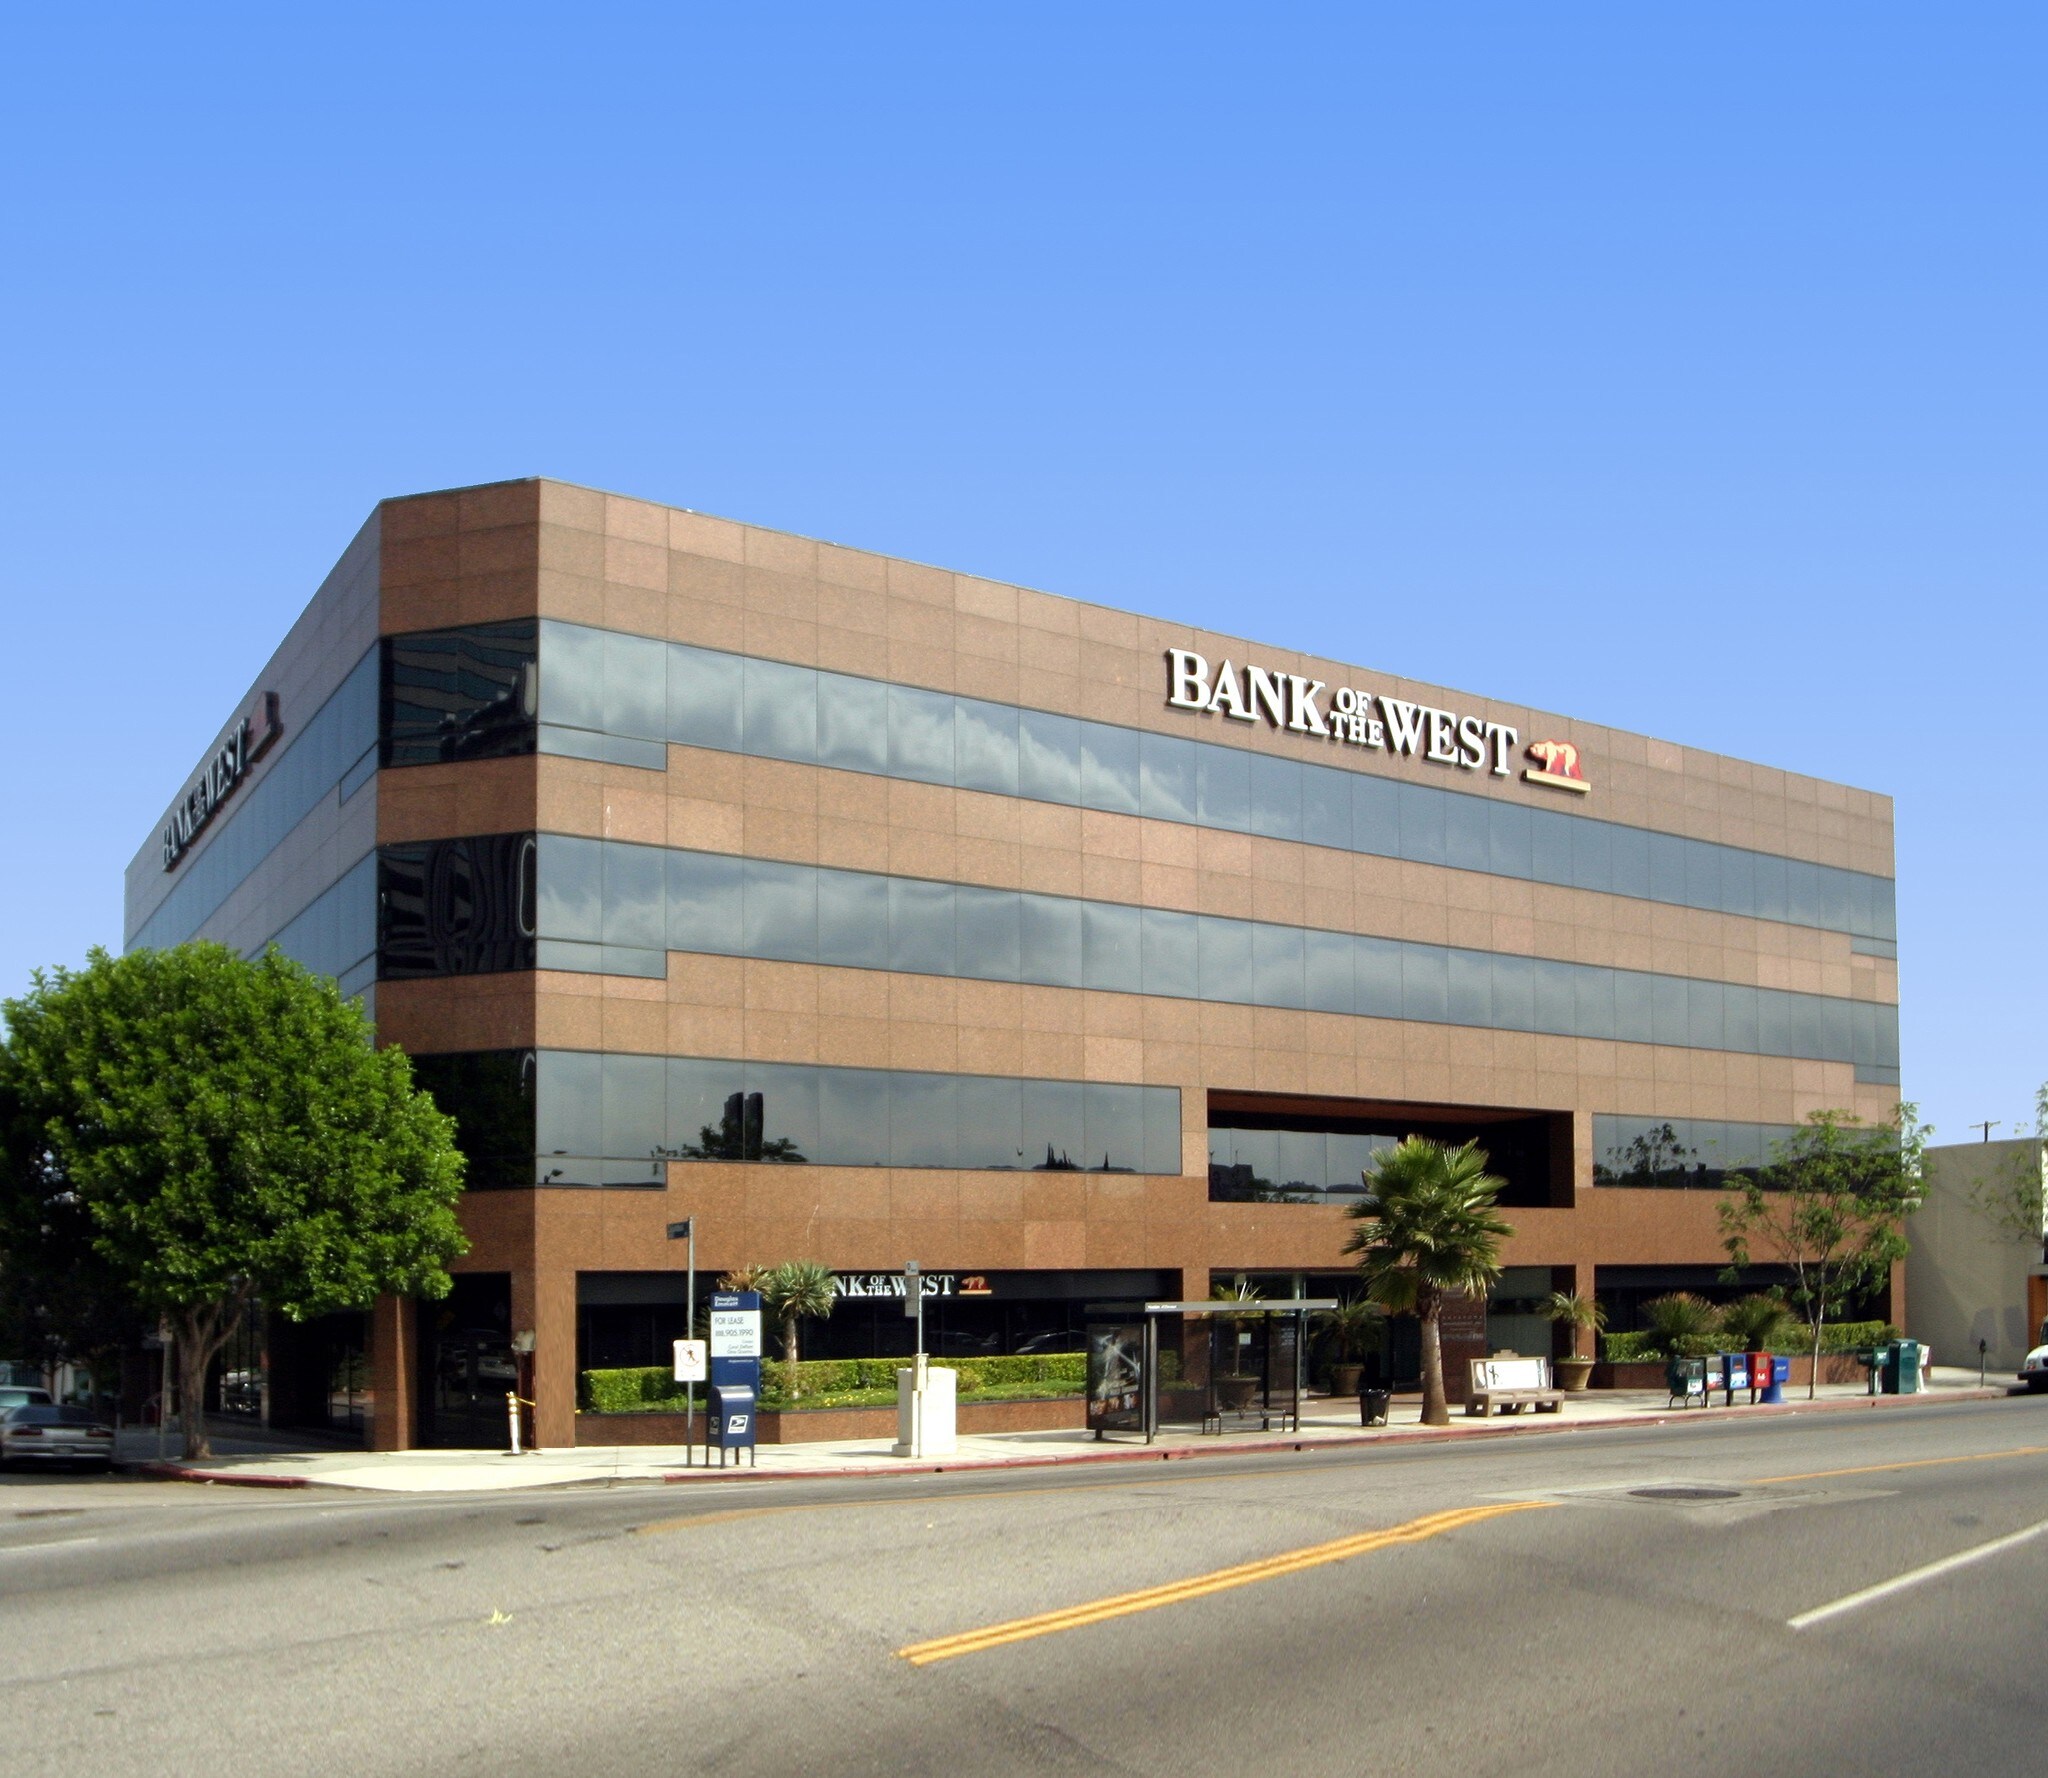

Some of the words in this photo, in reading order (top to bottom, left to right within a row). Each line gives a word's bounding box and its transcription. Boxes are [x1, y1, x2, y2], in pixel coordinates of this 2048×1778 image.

[1168, 648, 1331, 736] BANK
[1336, 687, 1372, 715] OF
[1329, 711, 1384, 748] THE
[1379, 696, 1518, 775] WEST
[830, 1274, 868, 1297] NK
[866, 1285, 892, 1296] THE
[870, 1275, 887, 1286] OF
[715, 1317, 726, 1325] FOR
[728, 1316, 744, 1325] LEASE
